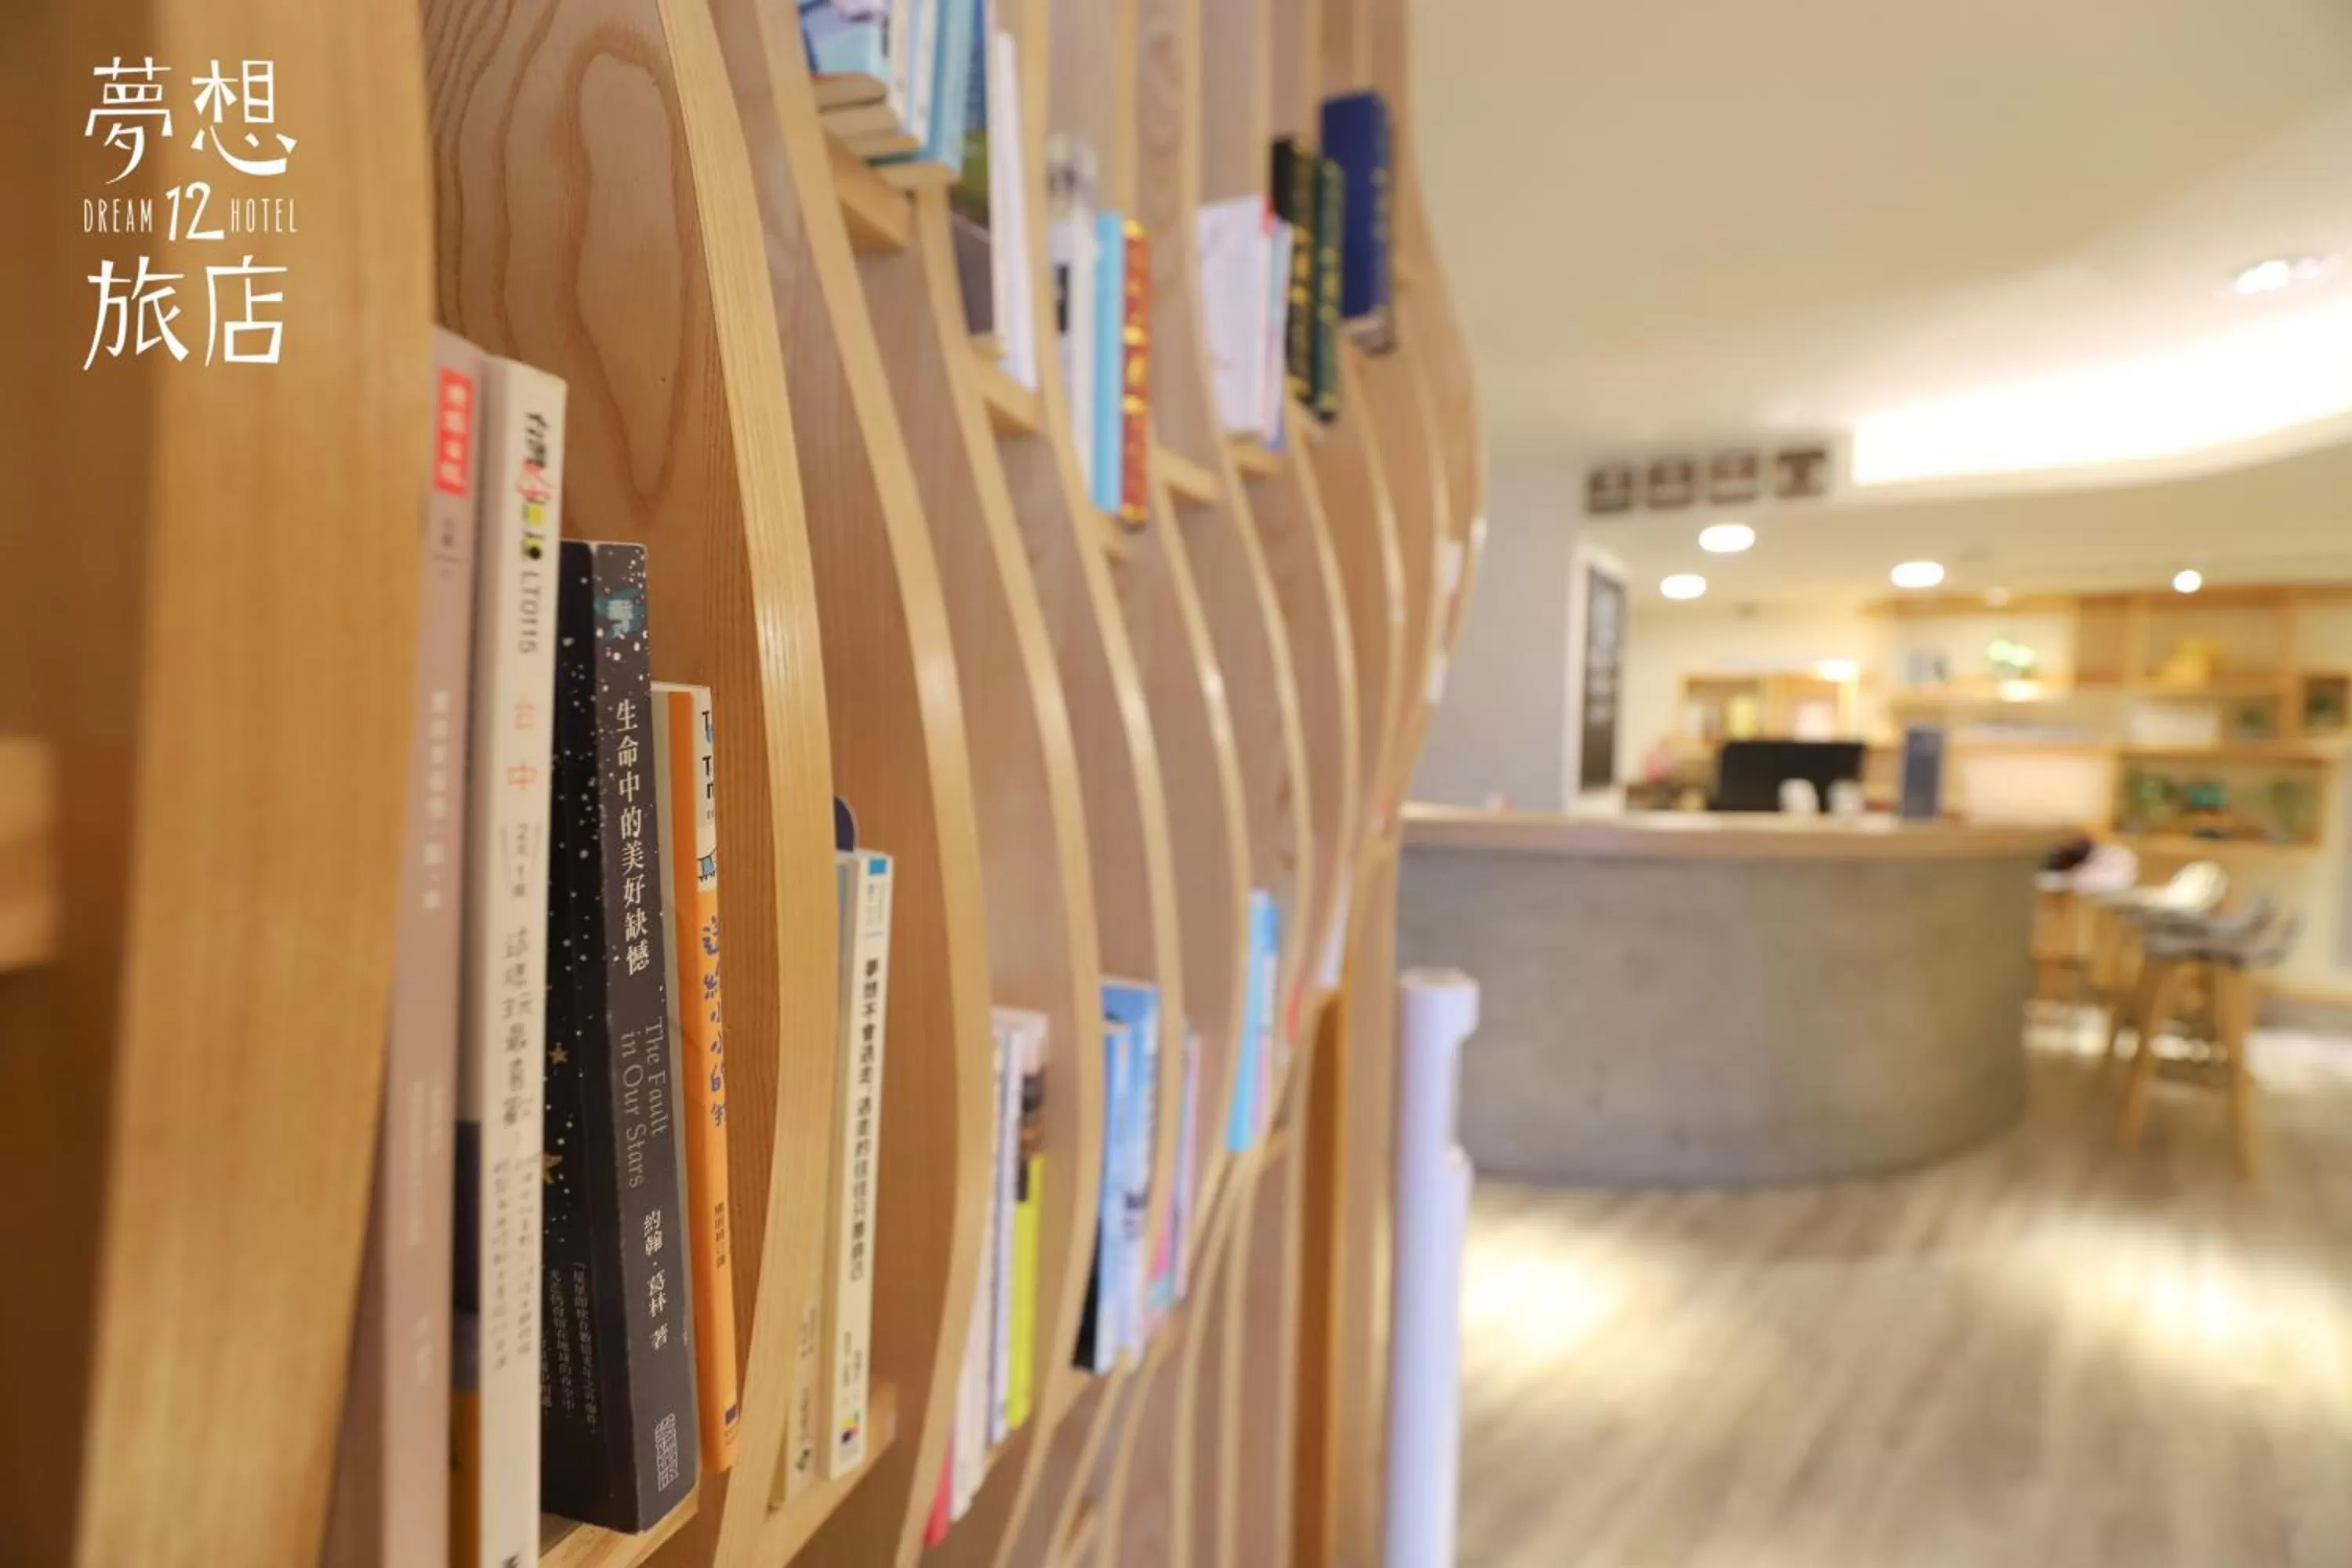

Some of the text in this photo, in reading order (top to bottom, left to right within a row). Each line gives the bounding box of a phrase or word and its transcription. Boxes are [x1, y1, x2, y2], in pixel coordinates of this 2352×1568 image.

[616, 699, 650, 975] 生命中的美好缺憾
[620, 1031, 648, 1189] in Our Stars
[645, 1016, 668, 1135] The Fault
